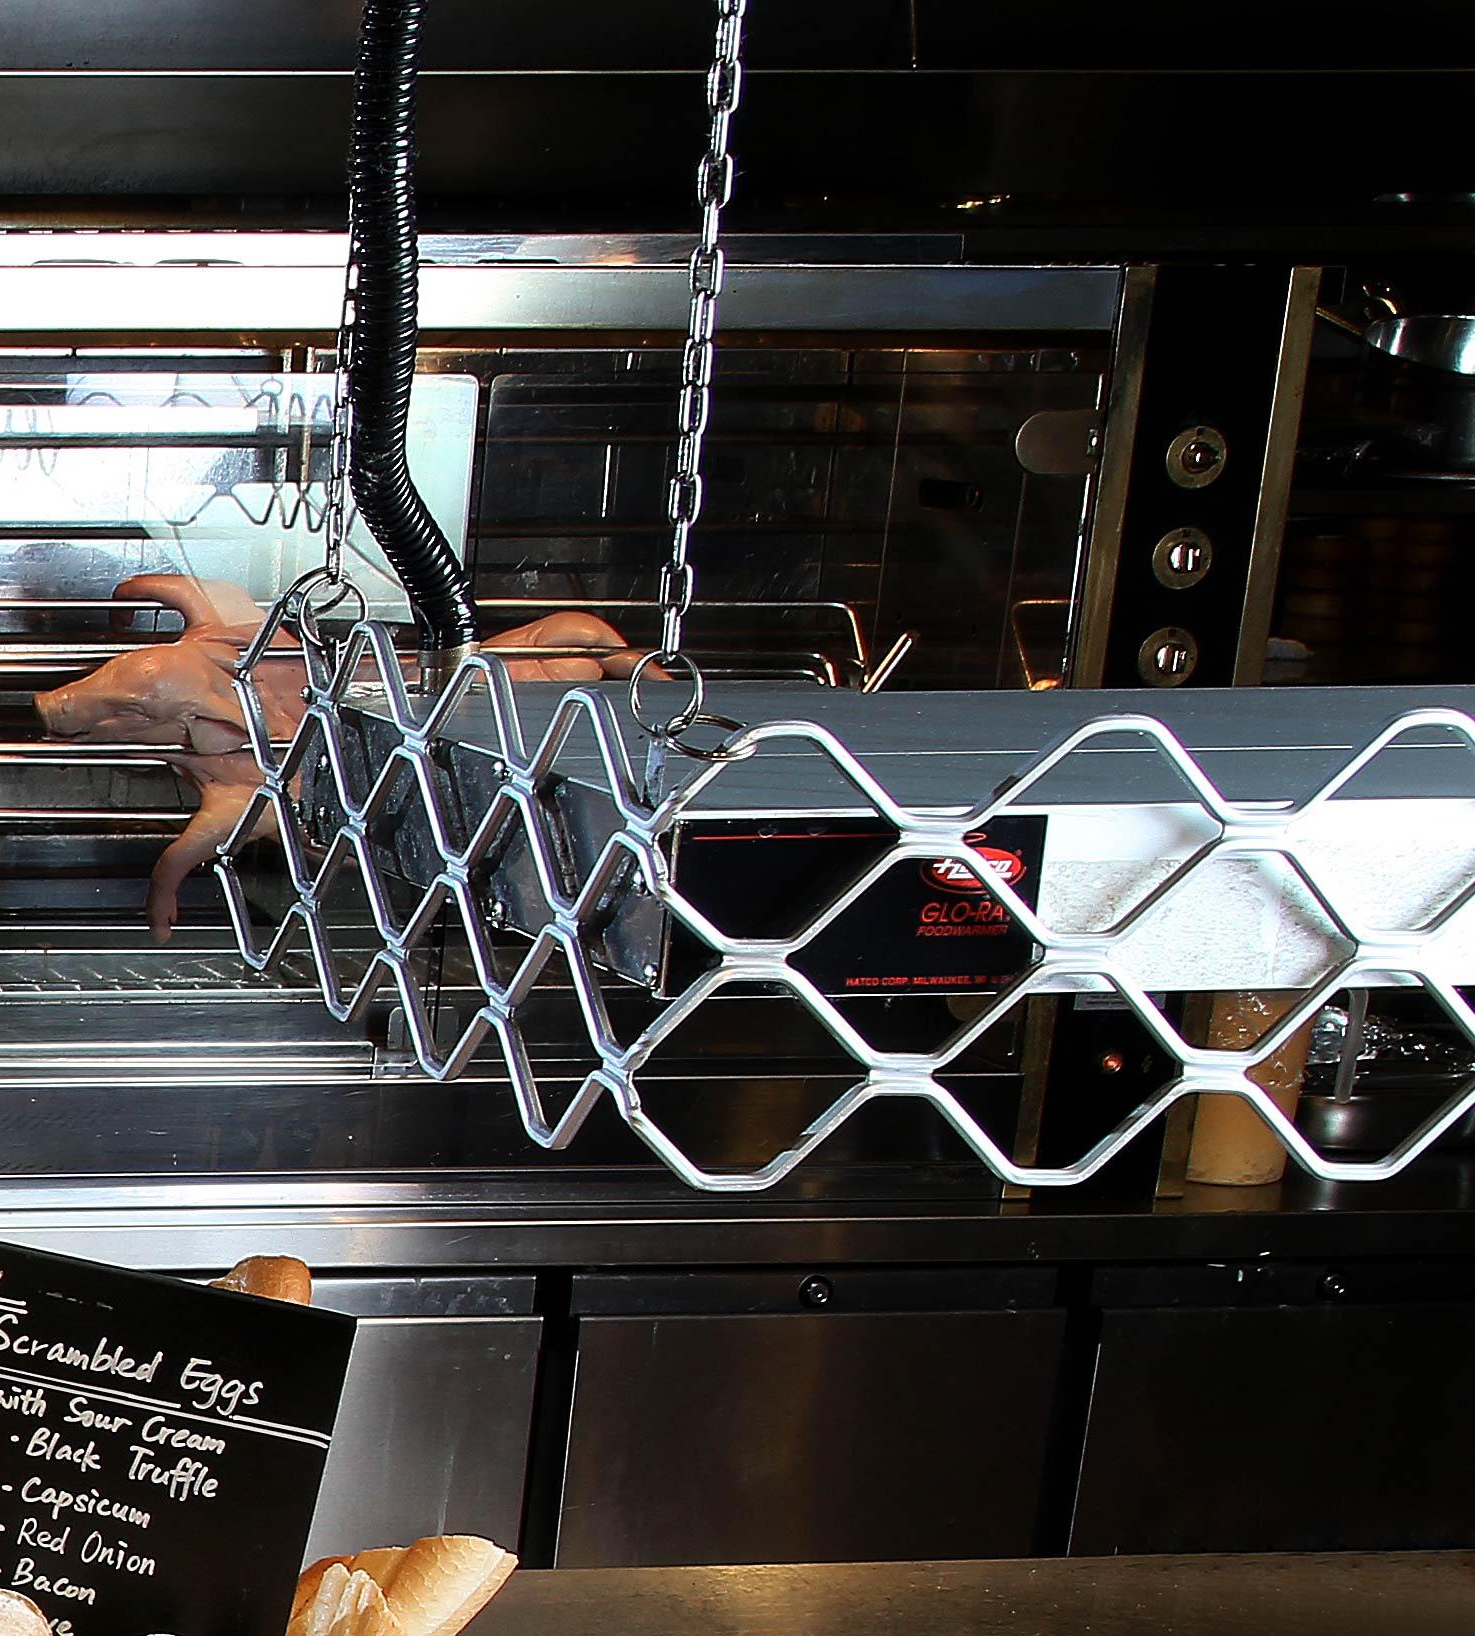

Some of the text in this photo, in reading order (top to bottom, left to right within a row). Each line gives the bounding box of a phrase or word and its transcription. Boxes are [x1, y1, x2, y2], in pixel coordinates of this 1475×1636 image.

[921, 901, 1011, 923] GLO-RA
[845, 977, 879, 986] HATCO
[180, 1359, 263, 1417] Eggs
[64, 1399, 131, 1433] Sour
[142, 1415, 225, 1455] Cream
[26, 1431, 218, 1501] Black Truffle
[22, 1478, 151, 1528] Capsicum
[18, 1518, 155, 1576] Red Onion
[14, 1561, 95, 1605] Bacon
